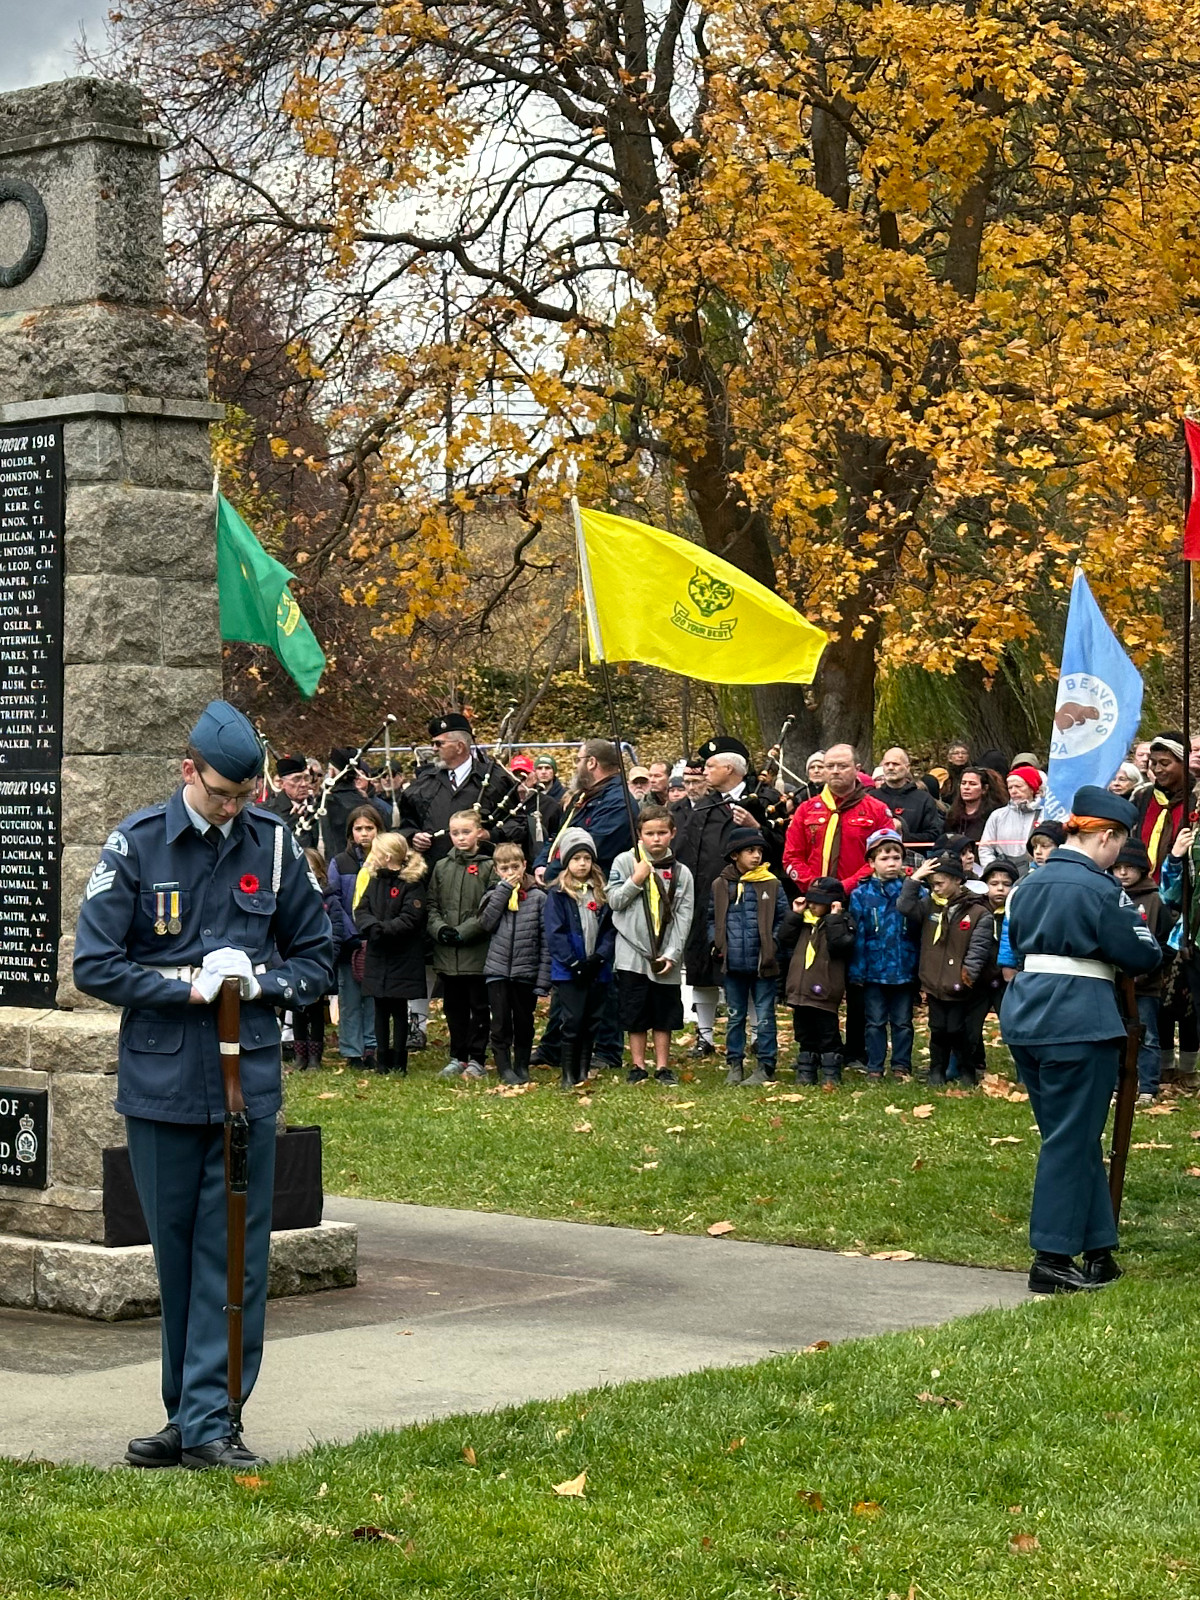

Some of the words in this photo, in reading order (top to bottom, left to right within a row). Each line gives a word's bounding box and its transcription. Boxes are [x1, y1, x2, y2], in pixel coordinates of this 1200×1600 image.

[32, 434, 55, 448] 1918
[18, 590, 35, 600] (NS)
[675, 616, 687, 626] DO
[687, 623, 706, 635] YOUR
[707, 629, 728, 638] BEST
[1065, 677, 1115, 737] BEAVERS
[30, 782, 56, 794] 1945
[0, 1099, 19, 1116] OF
